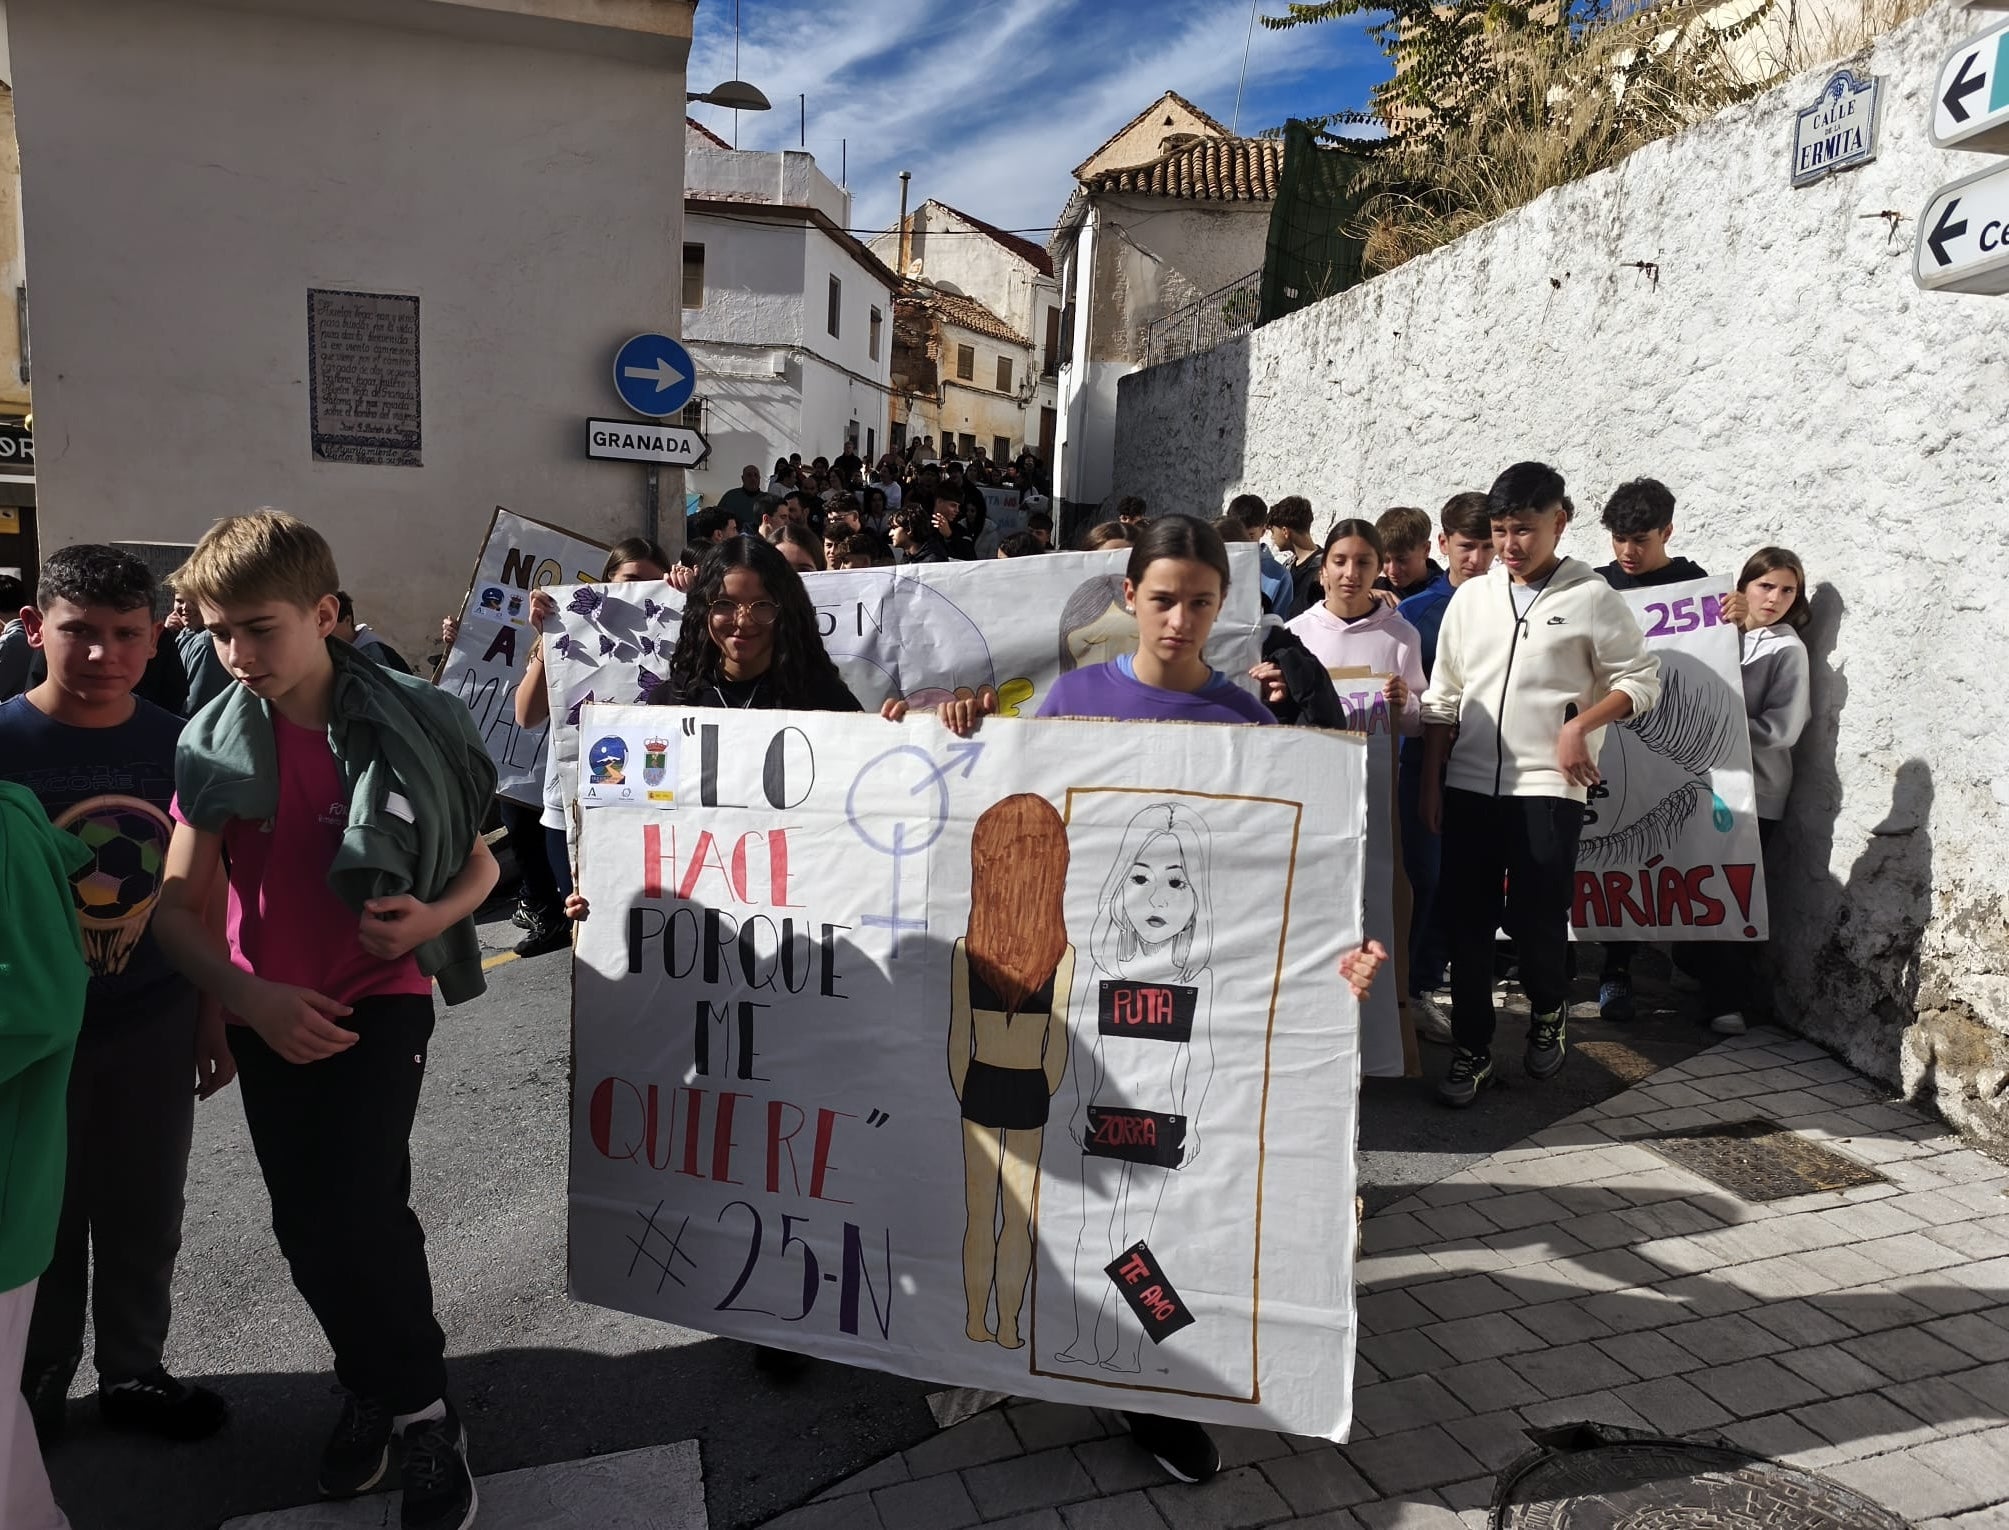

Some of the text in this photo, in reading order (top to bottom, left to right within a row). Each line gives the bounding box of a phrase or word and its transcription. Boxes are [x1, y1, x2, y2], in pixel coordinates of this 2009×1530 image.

[1813, 99, 1856, 130] CALLE
[1801, 125, 1862, 170] ERMITA
[593, 431, 691, 454] GRANADA
[482, 625, 517, 668] A
[643, 823, 807, 908] HACE
[628, 907, 852, 999] PORQUE
[1114, 988, 1174, 1025] PUTA
[695, 1001, 772, 1082] ME
[1093, 1115, 1157, 1147] ZORRA
[1119, 1252, 1177, 1322] TE AMO
